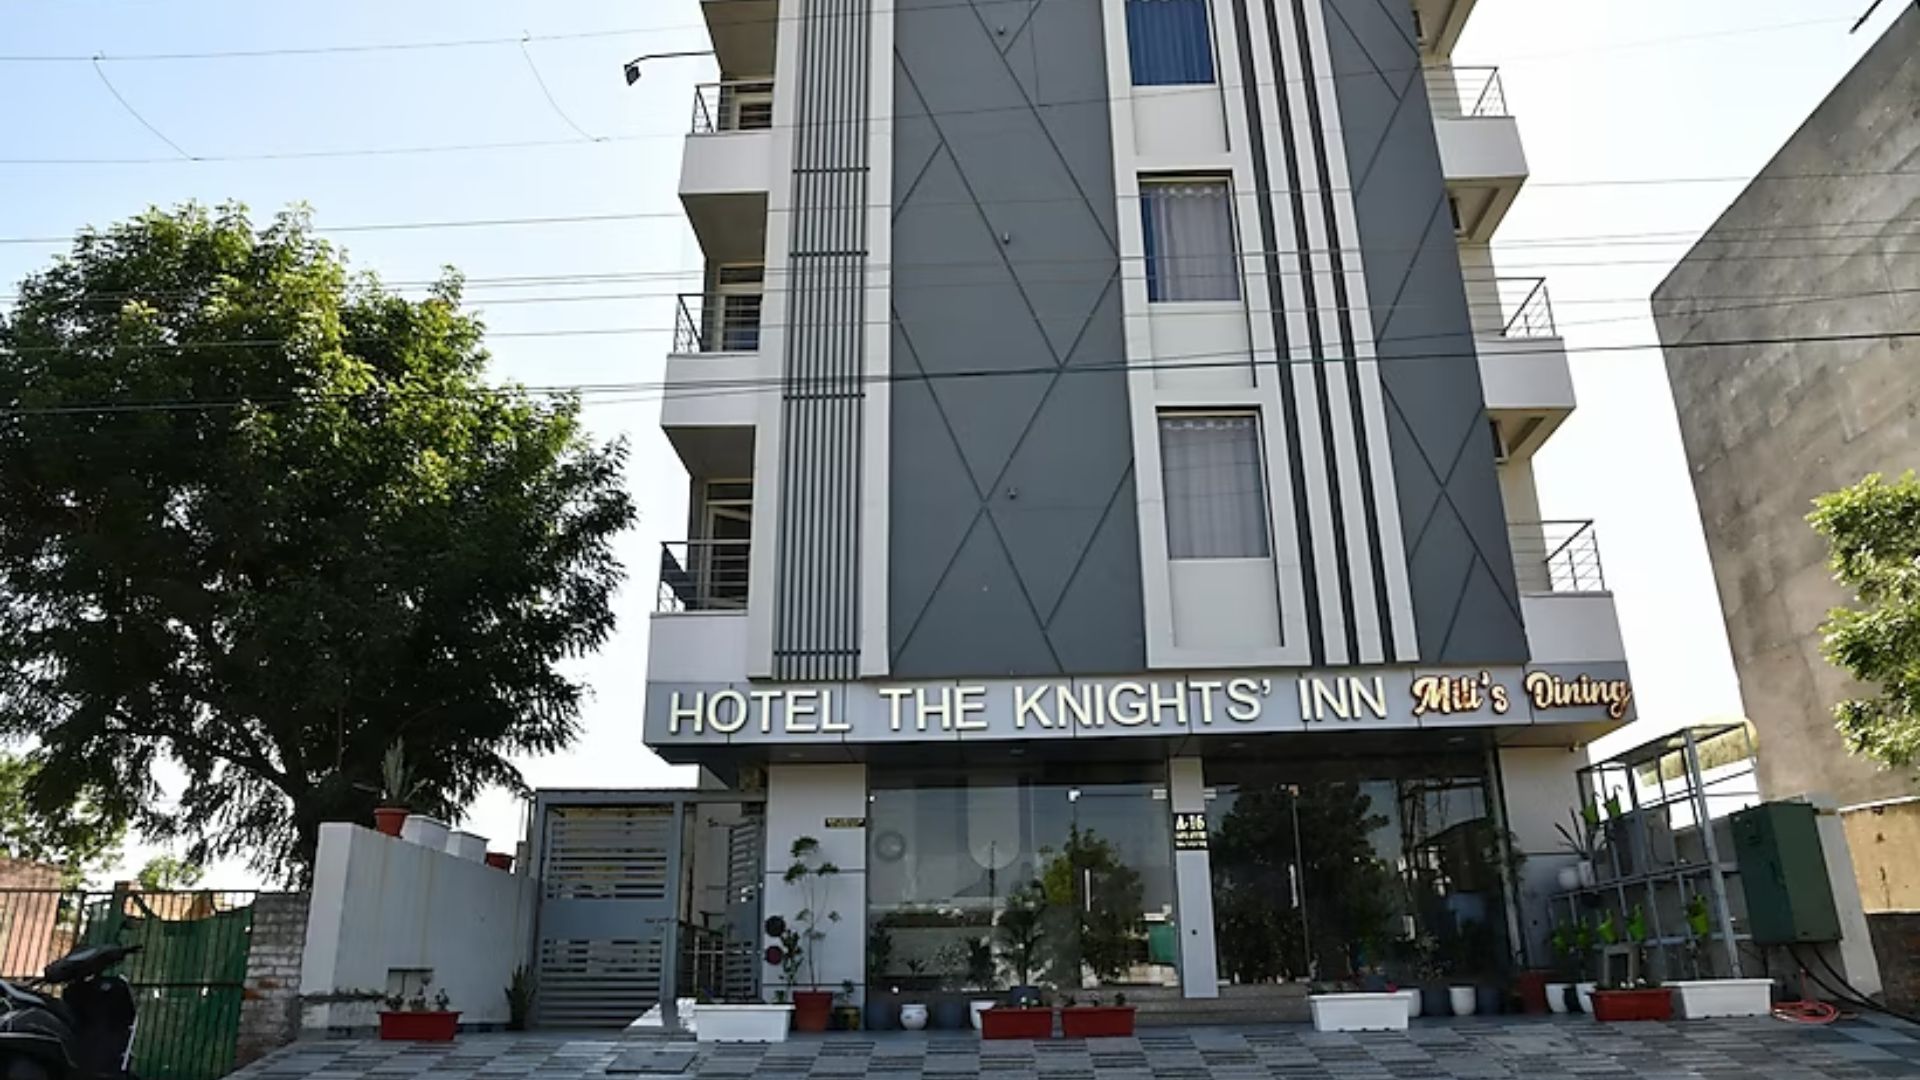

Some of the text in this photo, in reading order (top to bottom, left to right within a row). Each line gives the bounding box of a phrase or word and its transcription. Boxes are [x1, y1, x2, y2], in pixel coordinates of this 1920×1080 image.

[668, 689, 852, 734] HOTEL
[879, 686, 988, 731] THE
[1298, 676, 1388, 721] INN
[1525, 671, 1631, 718] Dining
